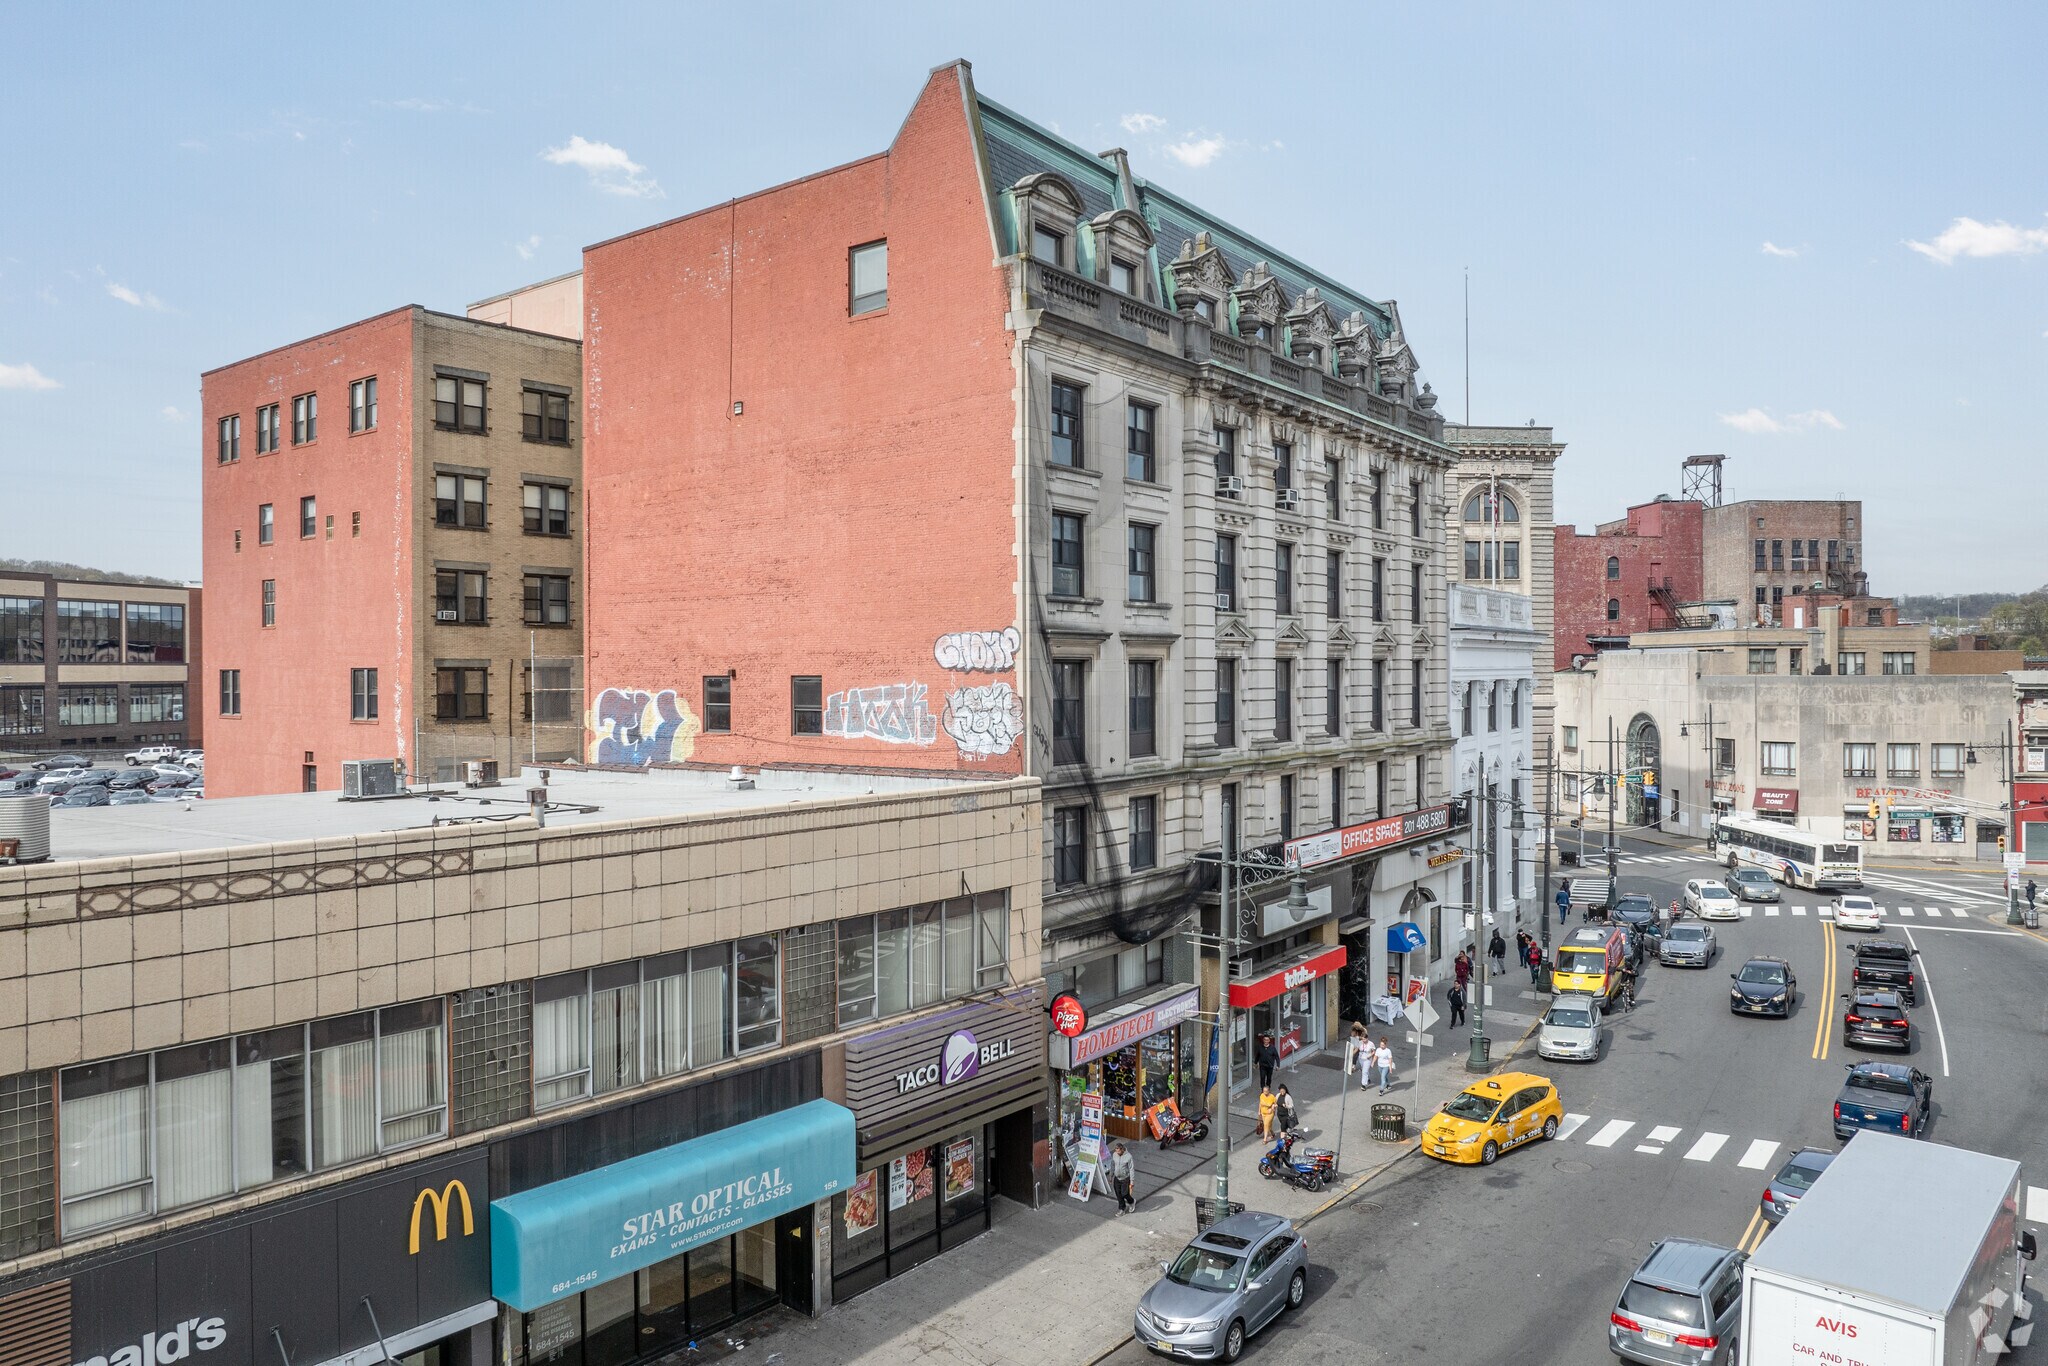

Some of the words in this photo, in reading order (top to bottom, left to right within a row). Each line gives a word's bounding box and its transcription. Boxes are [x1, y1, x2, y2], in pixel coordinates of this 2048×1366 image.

[1729, 783, 1745, 793] ZONE
[1914, 788, 1952, 799] ZONE
[1343, 827, 1374, 850] OFFICE
[1375, 821, 1401, 842] SPACE
[1404, 820, 1415, 834] 201
[1416, 814, 1430, 830] 488
[1430, 810, 1447, 827] 5800
[1430, 854, 1447, 867] WELLS
[1057, 1011, 1079, 1023] Pizza
[1158, 996, 1198, 1022] ELECTRONICS
[1060, 1019, 1078, 1030] Hut
[1075, 1011, 1156, 1061] HOMETECH
[897, 1064, 939, 1092] TACO
[981, 1038, 1015, 1066] BELL
[823, 1180, 838, 1191] 158
[622, 1202, 684, 1241] STAR
[691, 1167, 785, 1215] OPTICAL
[610, 1232, 657, 1259] EXAMS
[669, 1206, 732, 1237] CONTACTS
[743, 1183, 793, 1210] GLASSES
[671, 1216, 744, 1249] www.STAROPT.com
[552, 1270, 598, 1294] 684-1545
[1816, 1316, 1857, 1338] AVIS
[536, 1329, 575, 1351] 684-1545
[1792, 1343, 1815, 1356] CAR
[1819, 1351, 1842, 1364] AND
